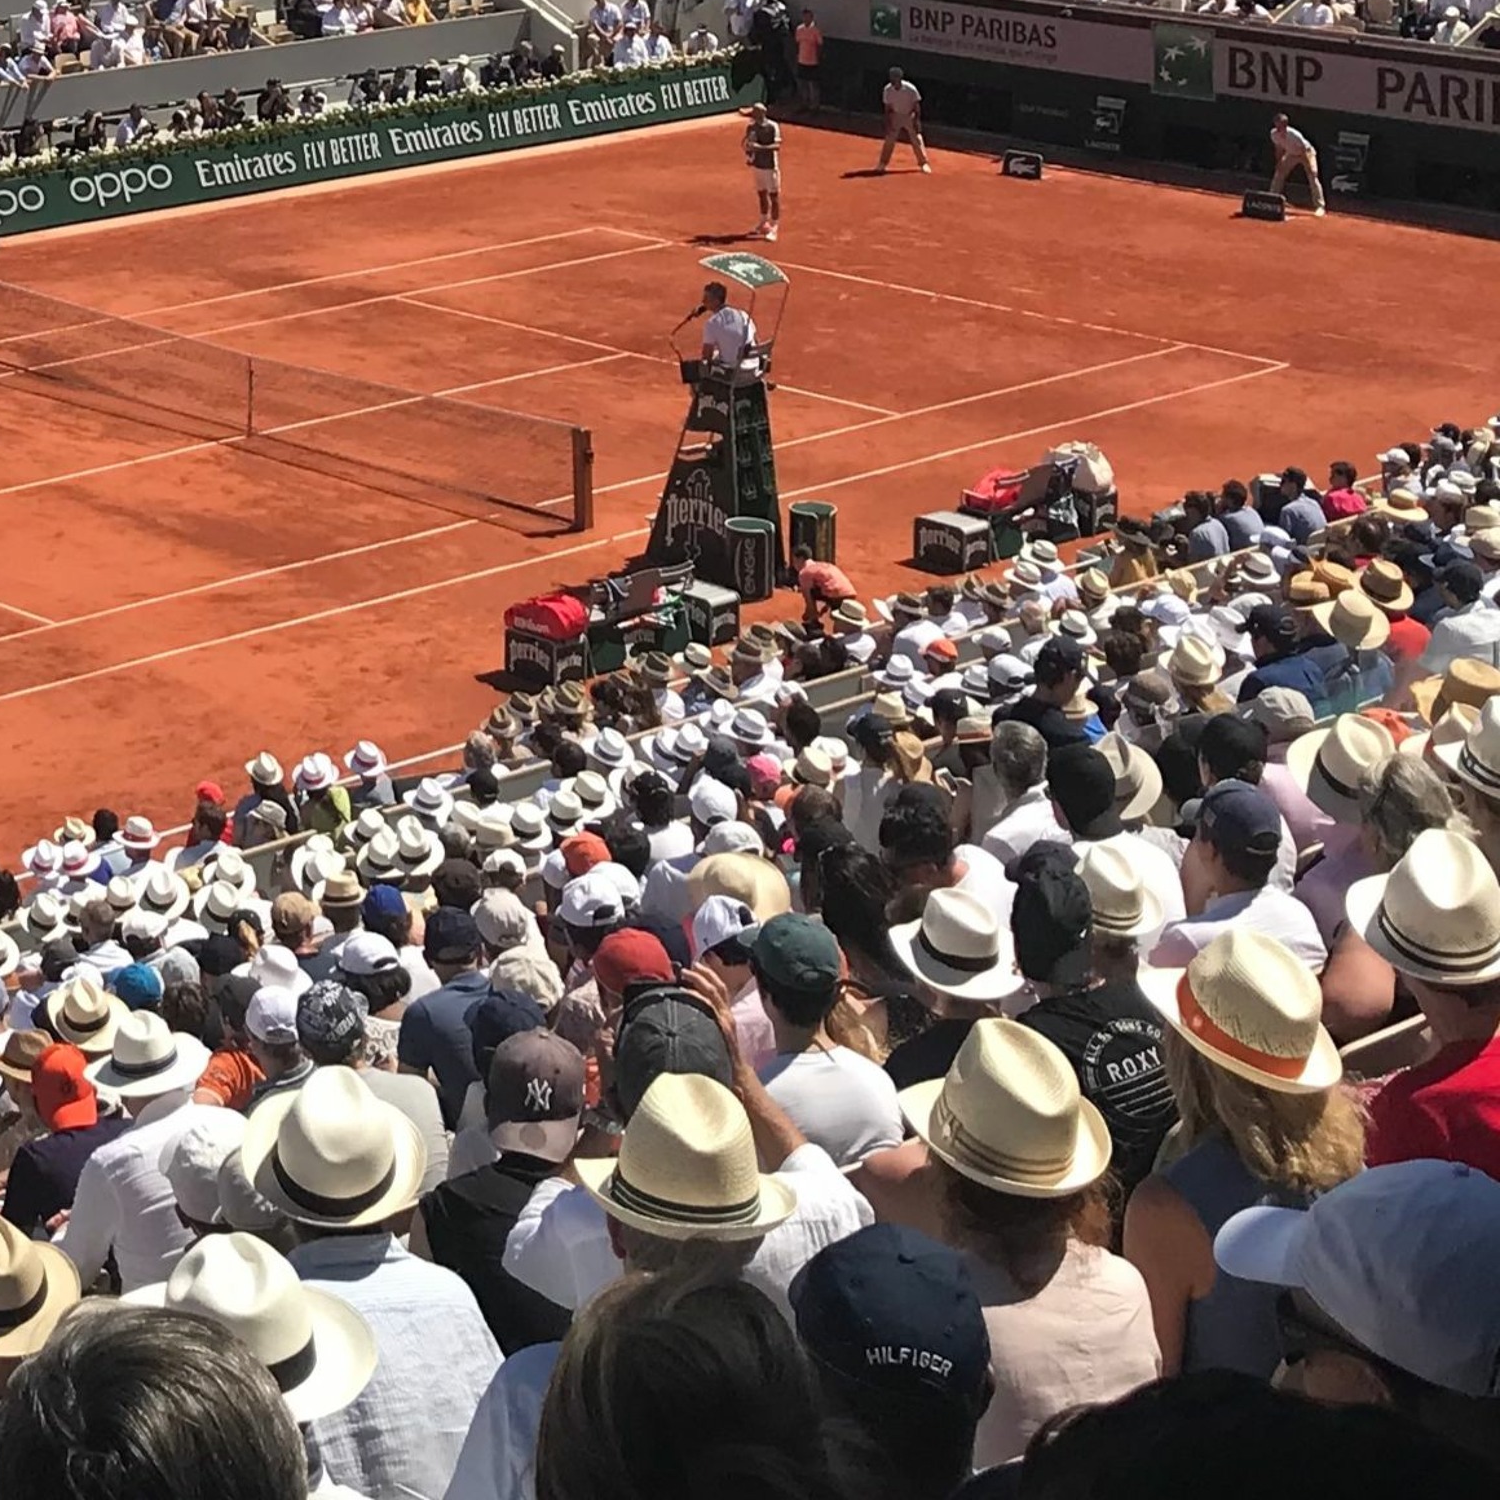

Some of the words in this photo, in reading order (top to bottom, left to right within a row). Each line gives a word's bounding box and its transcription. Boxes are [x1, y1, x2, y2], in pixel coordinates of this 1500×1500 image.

[909, 6, 955, 32] BNP
[961, 14, 1057, 48] PARIBAS
[1227, 47, 1323, 98] BNP
[1376, 67, 1500, 125] PARI
[195, 151, 297, 187] Emirates
[303, 140, 327, 170] FLY
[330, 132, 382, 166] BETTER
[388, 120, 483, 155] Emirates
[488, 111, 511, 140] FLY
[513, 103, 562, 135] BETTER
[567, 92, 657, 125] Emirates
[660, 82, 682, 110] FLY
[684, 75, 730, 106] BETTER
[69, 163, 173, 207] oppo
[524, 1077, 553, 1111] NY
[865, 1345, 953, 1378] HILFIGER
